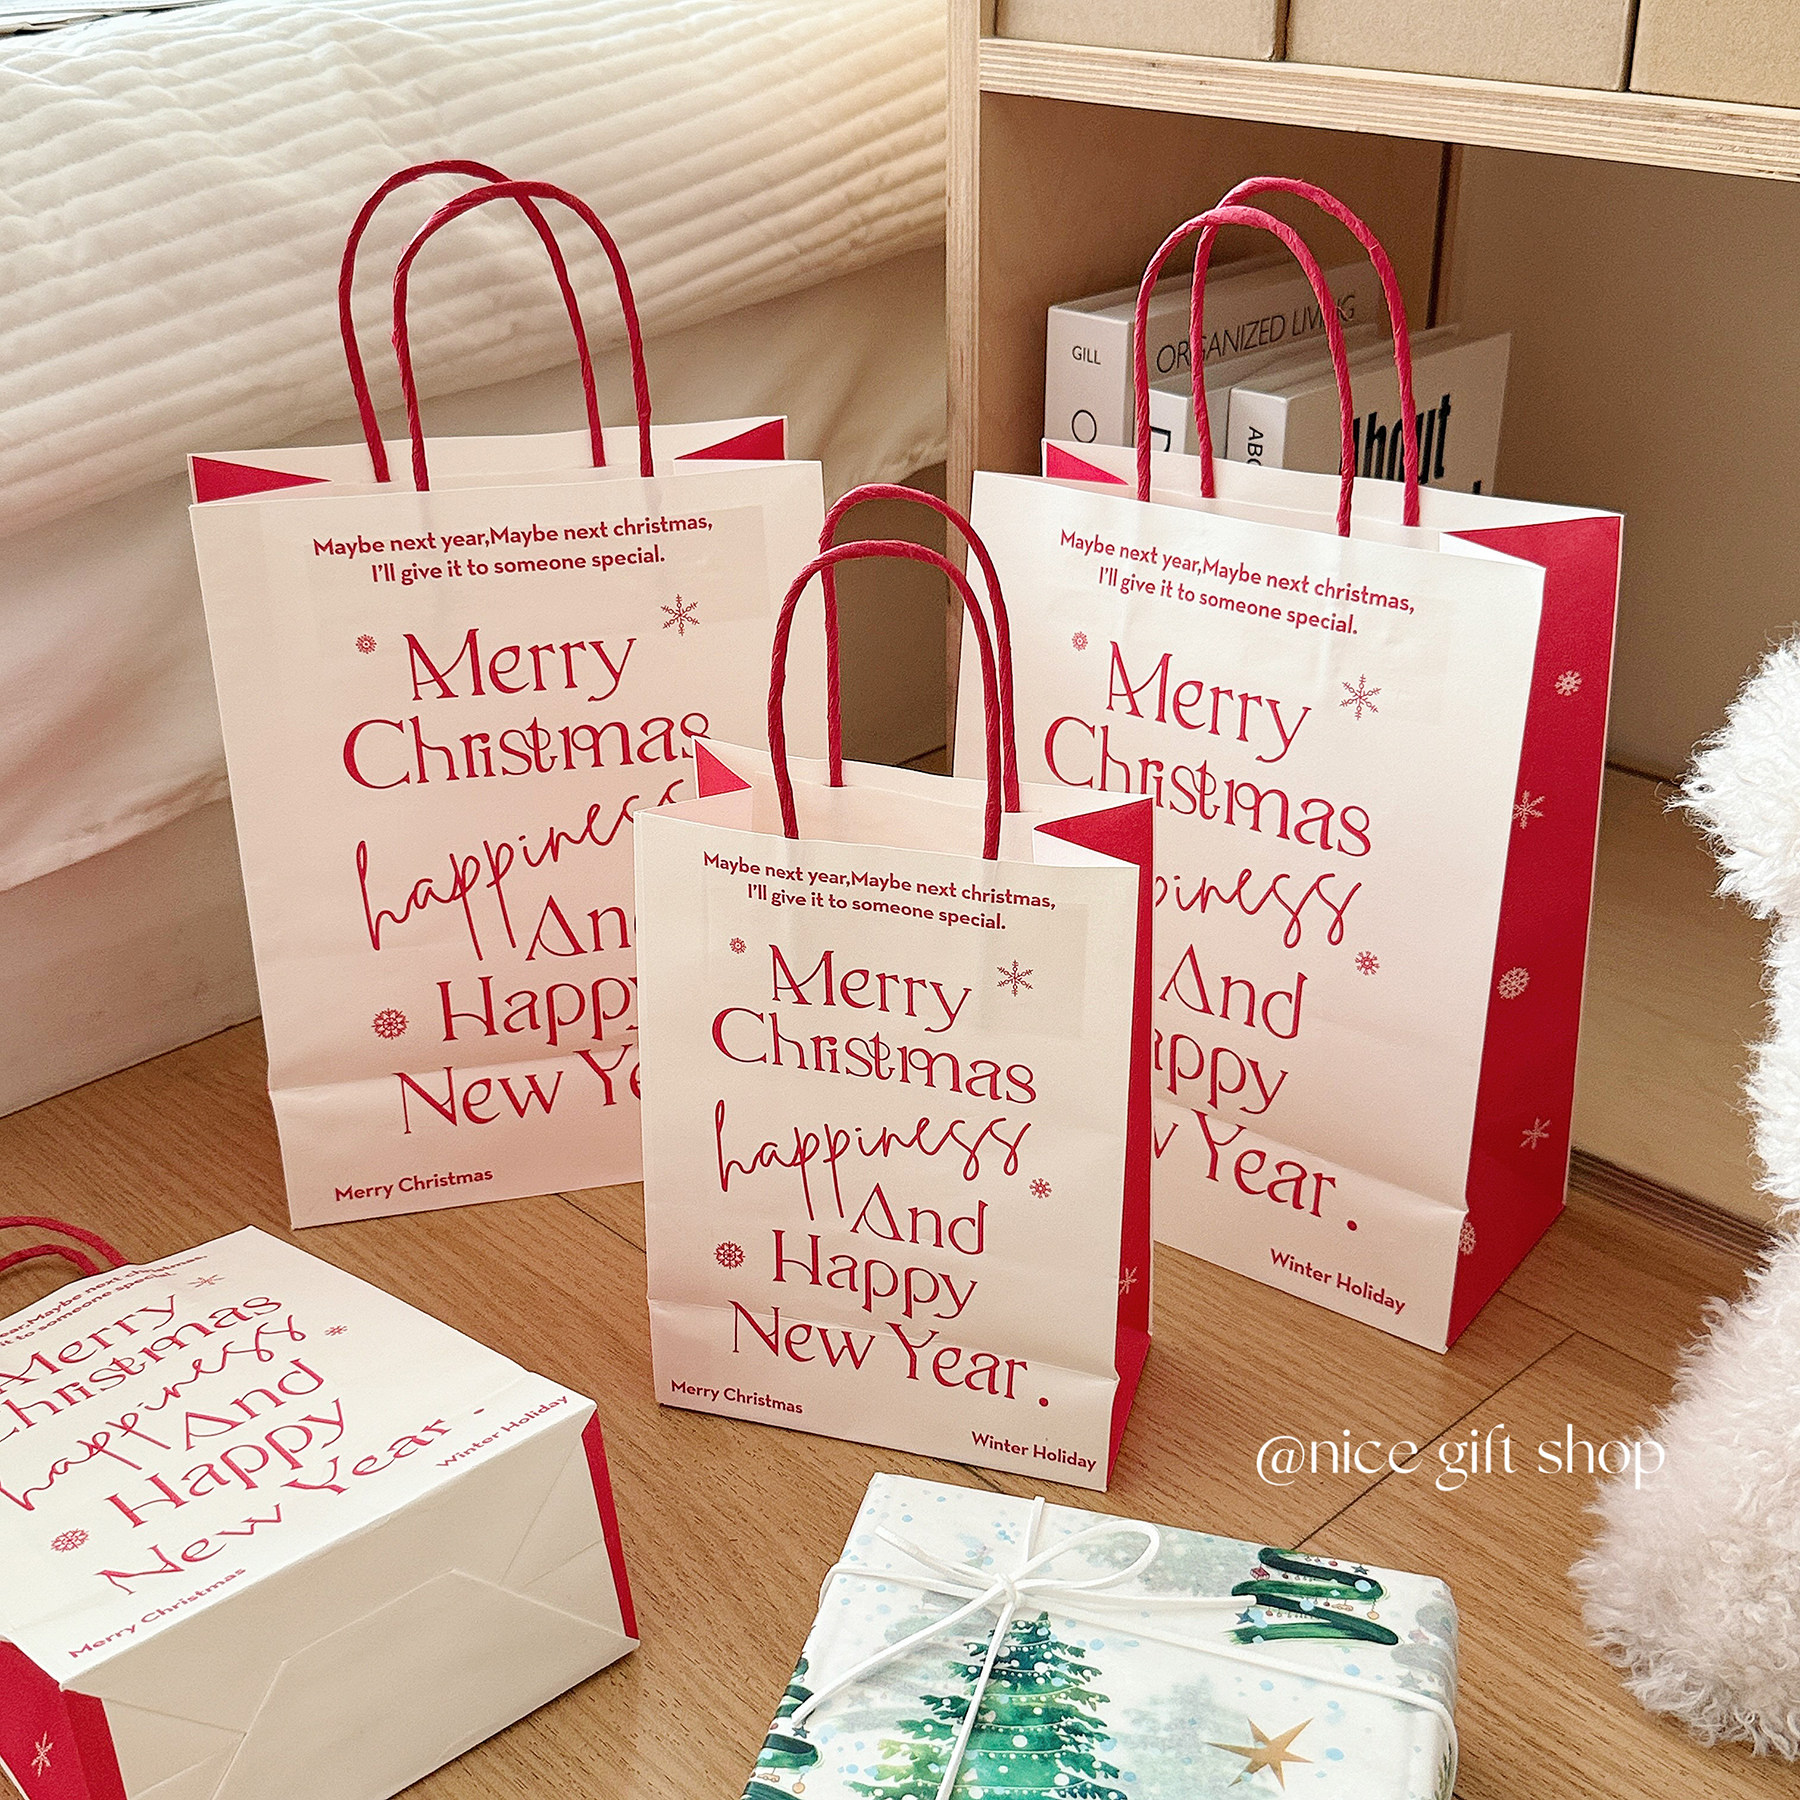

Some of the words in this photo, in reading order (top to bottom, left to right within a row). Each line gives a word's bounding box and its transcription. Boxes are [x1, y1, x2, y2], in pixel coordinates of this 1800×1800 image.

[1071, 345, 1102, 366] GILL
[1156, 314, 1286, 374] ORANIZED
[313, 535, 385, 560] Maybe
[390, 532, 437, 552] next
[563, 521, 609, 540] next
[612, 515, 713, 537] christmas,
[371, 562, 396, 583] I'll
[400, 563, 443, 586] give
[447, 559, 463, 578] it
[466, 558, 489, 576] to
[494, 557, 587, 574] someone
[591, 543, 665, 572] special.
[1060, 529, 1116, 557] Maybe
[1119, 545, 1158, 565] next
[1266, 574, 1310, 594] next
[1313, 577, 1415, 615] christmas,
[1098, 566, 1119, 587] I'll
[1119, 573, 1156, 596] give
[1160, 579, 1174, 598] it
[1177, 583, 1196, 603] to
[1199, 592, 1282, 620] someone
[1286, 610, 1358, 635] special.
[403, 627, 636, 703] Merry
[1105, 640, 1313, 764] Merry
[1044, 715, 1372, 858] Christmas
[703, 851, 761, 875] Maybe
[765, 866, 803, 882] next
[916, 882, 957, 897] next
[961, 884, 1056, 908] christmas,
[747, 883, 768, 901] I'll
[771, 889, 807, 907] give
[811, 893, 824, 907] it
[828, 894, 848, 909] to
[852, 900, 935, 920] someone
[938, 910, 1007, 931] special.
[526, 894, 636, 962] An
[770, 944, 972, 1033] Merry
[1159, 943, 1308, 1040] And
[711, 1007, 1037, 1105] Christmas
[395, 1066, 563, 1134] New
[334, 1184, 393, 1201] Merry
[398, 1170, 493, 1193] Christmas
[714, 1099, 1031, 1220] happiness
[1191, 1108, 1336, 1217] Year
[850, 1183, 988, 1256] And
[85, 1277, 121, 1293] next
[772, 1229, 977, 1319] Happy
[1270, 1248, 1333, 1283] Winter
[1336, 1273, 1406, 1315] Holiday
[15, 1331, 35, 1340] to
[38, 1291, 112, 1331] someone
[730, 1300, 875, 1369] New
[888, 1322, 1028, 1400] Year
[0, 1297, 283, 1442] hristmas
[185, 1359, 324, 1450] And
[671, 1381, 719, 1399] Merry
[722, 1387, 803, 1415] Christmas
[106, 1399, 344, 1527] Happy
[438, 1433, 498, 1466] Winter
[502, 1396, 567, 1431] Holiday
[972, 1432, 1027, 1455] Winter
[1032, 1444, 1096, 1471] Holiday
[96, 1504, 282, 1594] New
[284, 1419, 457, 1494] Year
[70, 1625, 135, 1657] Merry
[141, 1570, 245, 1623] Christmas
